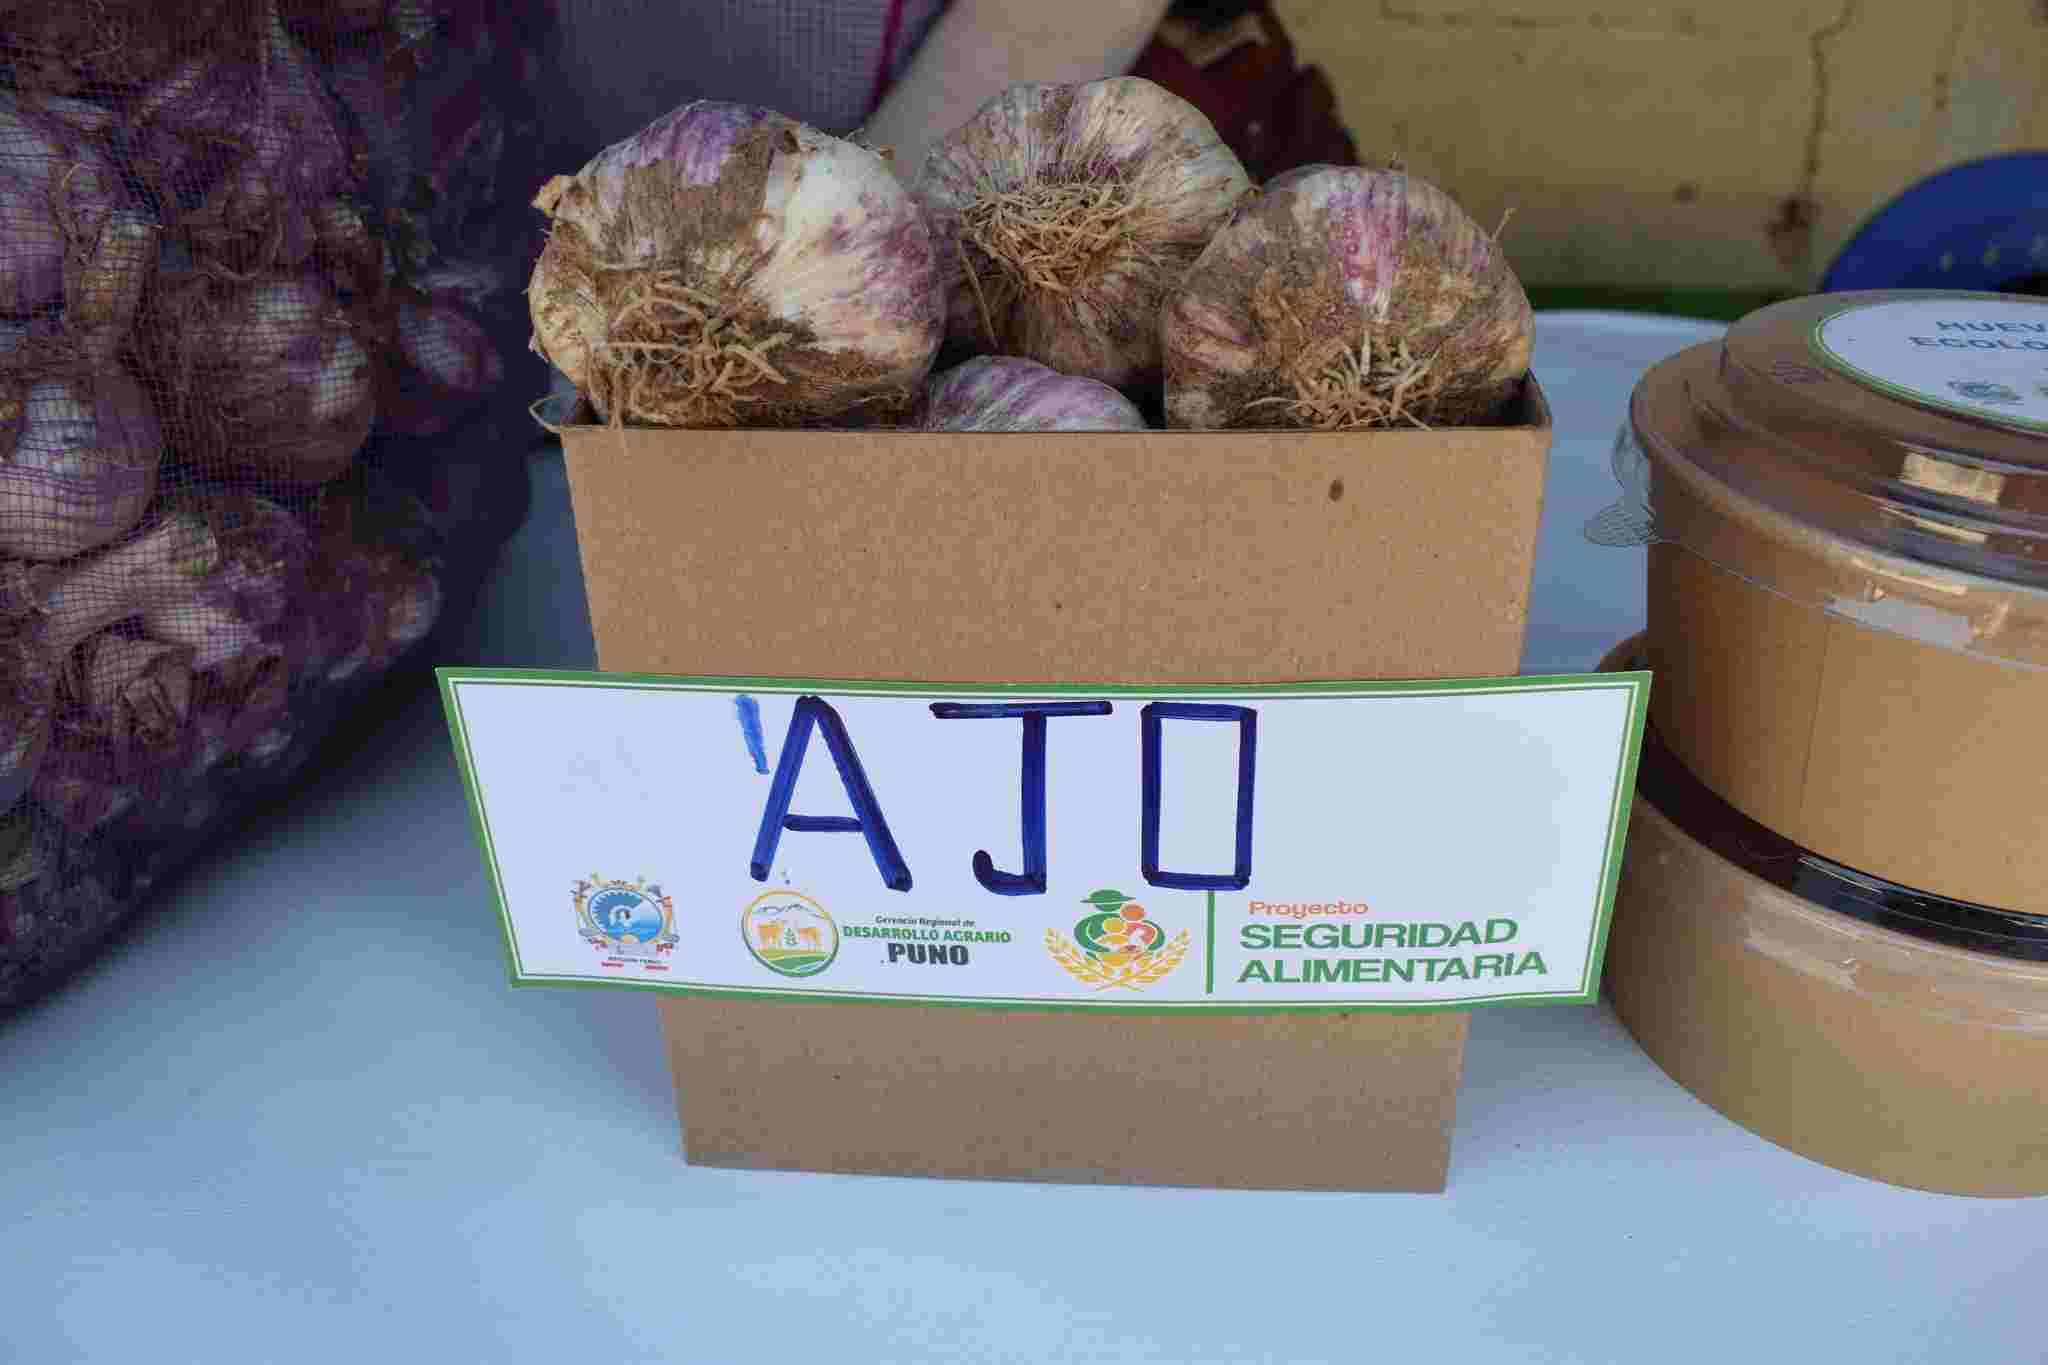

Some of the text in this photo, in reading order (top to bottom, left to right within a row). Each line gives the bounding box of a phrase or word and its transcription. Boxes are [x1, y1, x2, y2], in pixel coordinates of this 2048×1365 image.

[750, 696, 1257, 894] AJO
[1249, 901, 1369, 918] Proyecto
[843, 926, 1012, 943] DESARROLLO AGRARIO
[1240, 918, 1518, 949] SEGURIDAD
[887, 943, 969, 966] PUNO
[1236, 951, 1548, 983] ALIMENTARIA
